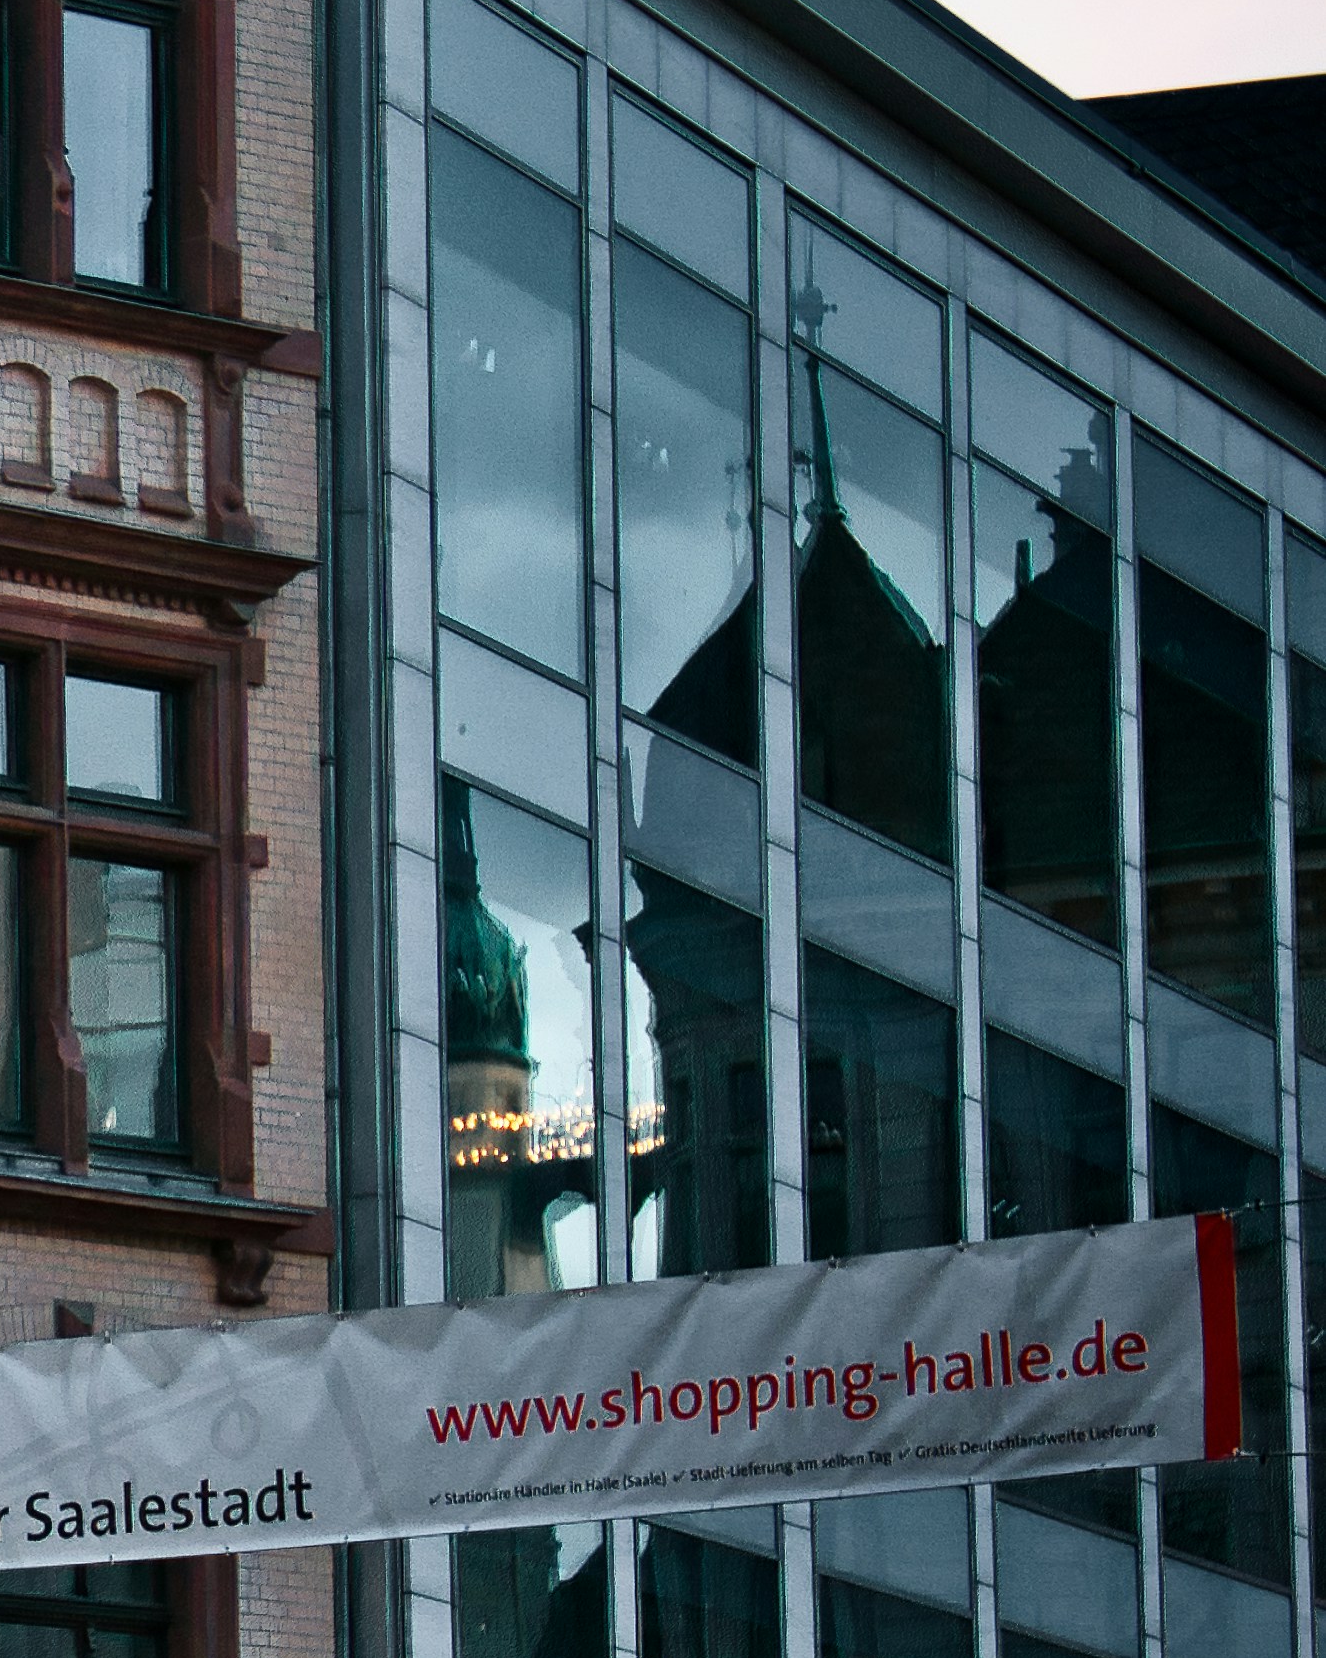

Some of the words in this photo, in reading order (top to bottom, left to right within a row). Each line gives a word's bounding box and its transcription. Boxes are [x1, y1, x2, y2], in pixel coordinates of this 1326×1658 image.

[426, 1319, 1150, 1444] www.shopping-halle.de
[25, 1468, 314, 1542] Saalestadt
[514, 1483, 568, 1499] Händler
[570, 1480, 583, 1496] in
[585, 1475, 621, 1492] Halle
[623, 1471, 668, 1490] (Saale)
[798, 1458, 820, 1472] am
[821, 1452, 866, 1470] selben
[868, 1449, 895, 1467] Tag
[915, 1442, 958, 1459] Gratis
